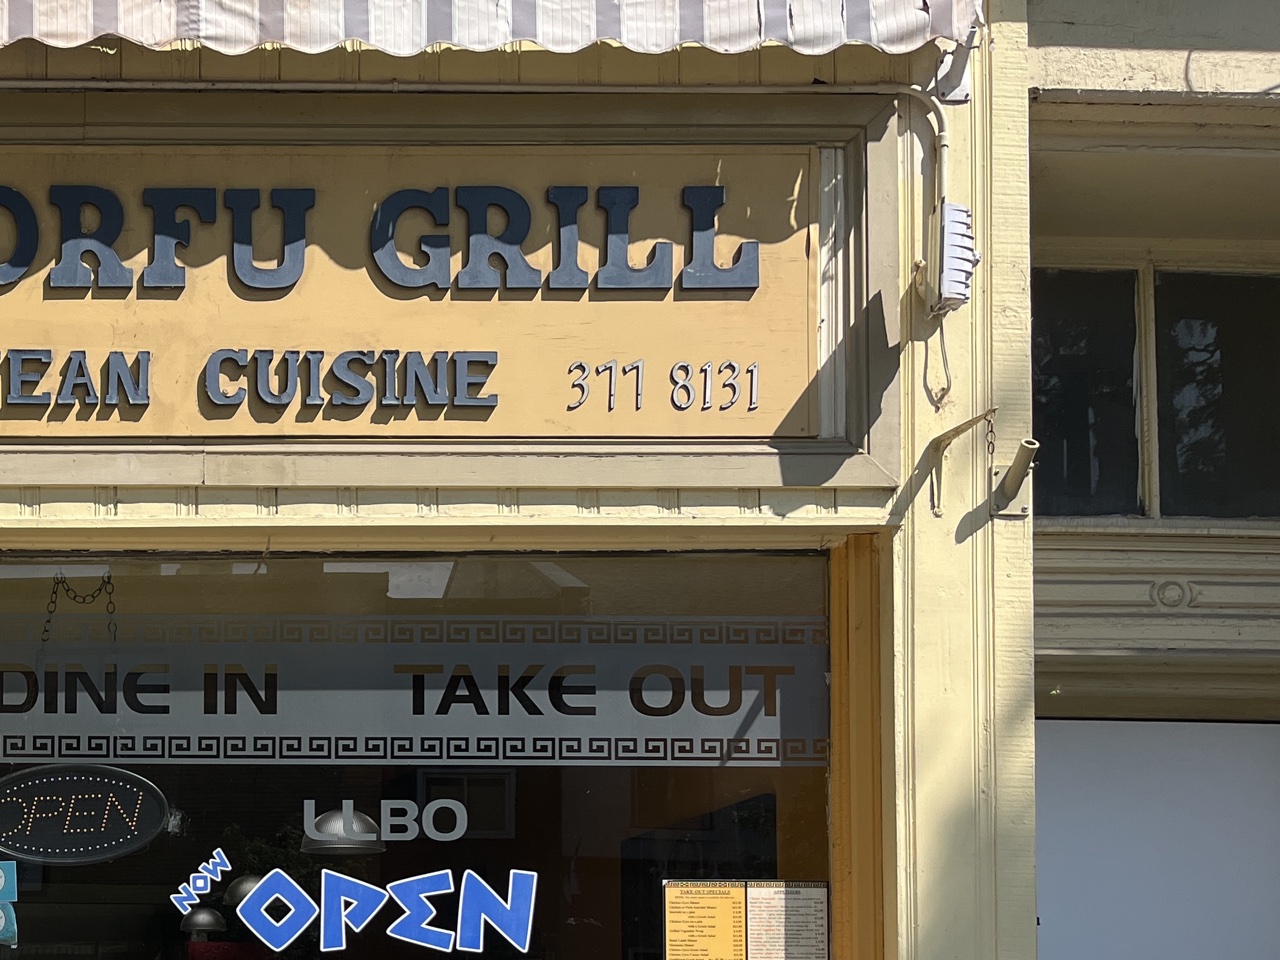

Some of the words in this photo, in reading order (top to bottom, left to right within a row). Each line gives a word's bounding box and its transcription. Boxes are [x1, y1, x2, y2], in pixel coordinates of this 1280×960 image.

[371, 185, 759, 291] GRILL
[205, 348, 499, 407] CUISINE
[567, 359, 644, 412] 377
[669, 361, 760, 412] 8131
[203, 664, 278, 715] IN
[393, 664, 597, 716] TAKE
[628, 664, 796, 717] OUT
[303, 799, 468, 841] LLBO
[170, 848, 232, 914] NOW
[236, 868, 538, 952] OPEN
